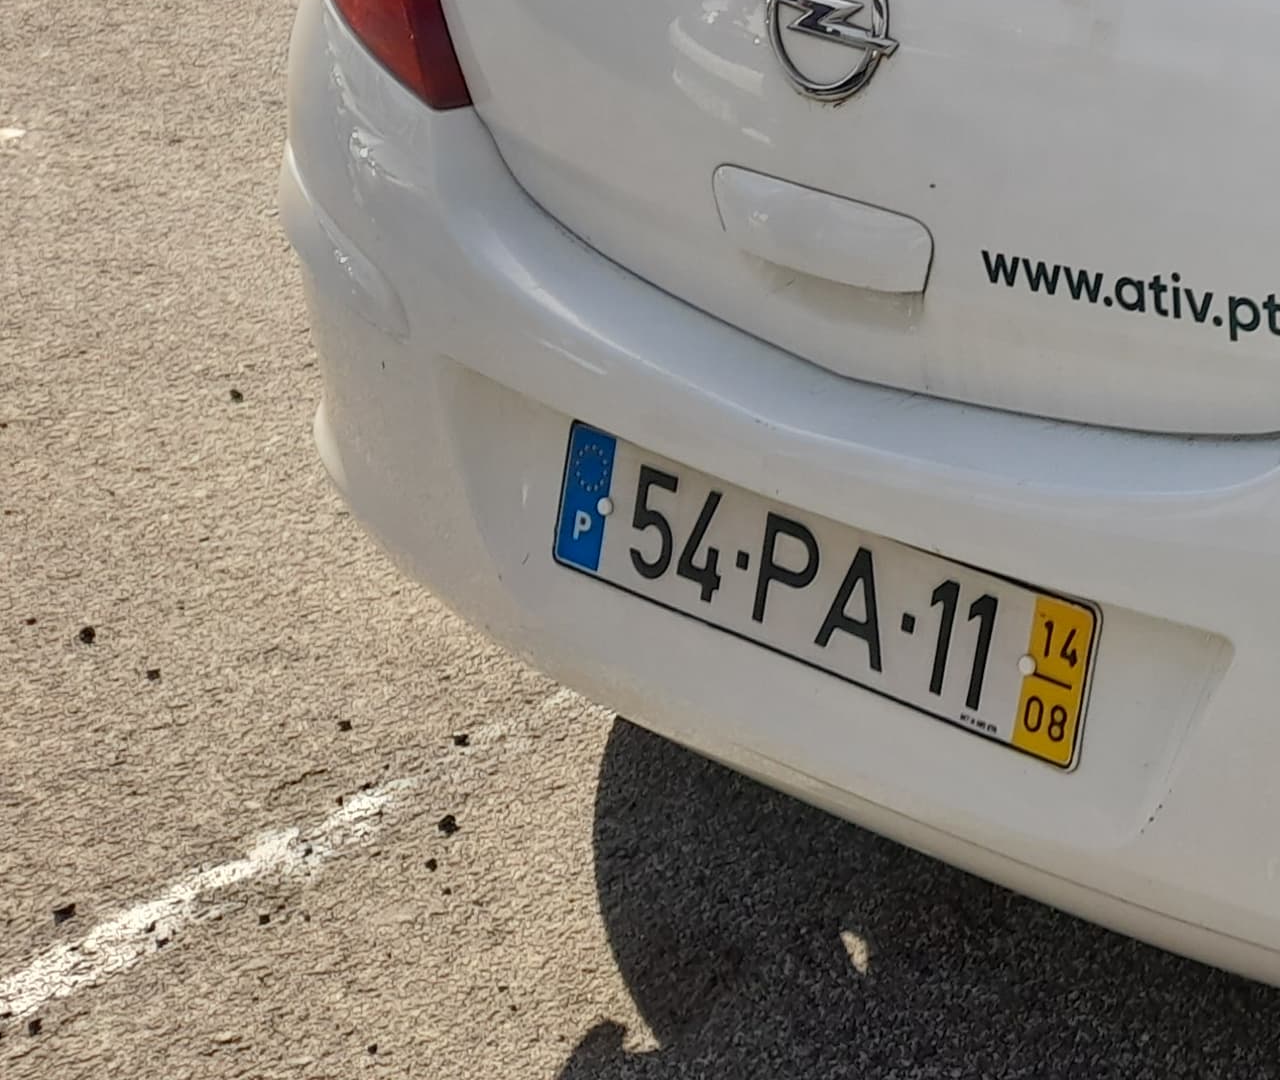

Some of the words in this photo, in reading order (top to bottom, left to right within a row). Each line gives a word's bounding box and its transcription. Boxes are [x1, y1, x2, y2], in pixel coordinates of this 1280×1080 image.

[573, 510, 592, 540] P
[1043, 619, 1079, 669] 14
[1023, 695, 1068, 743] 08
